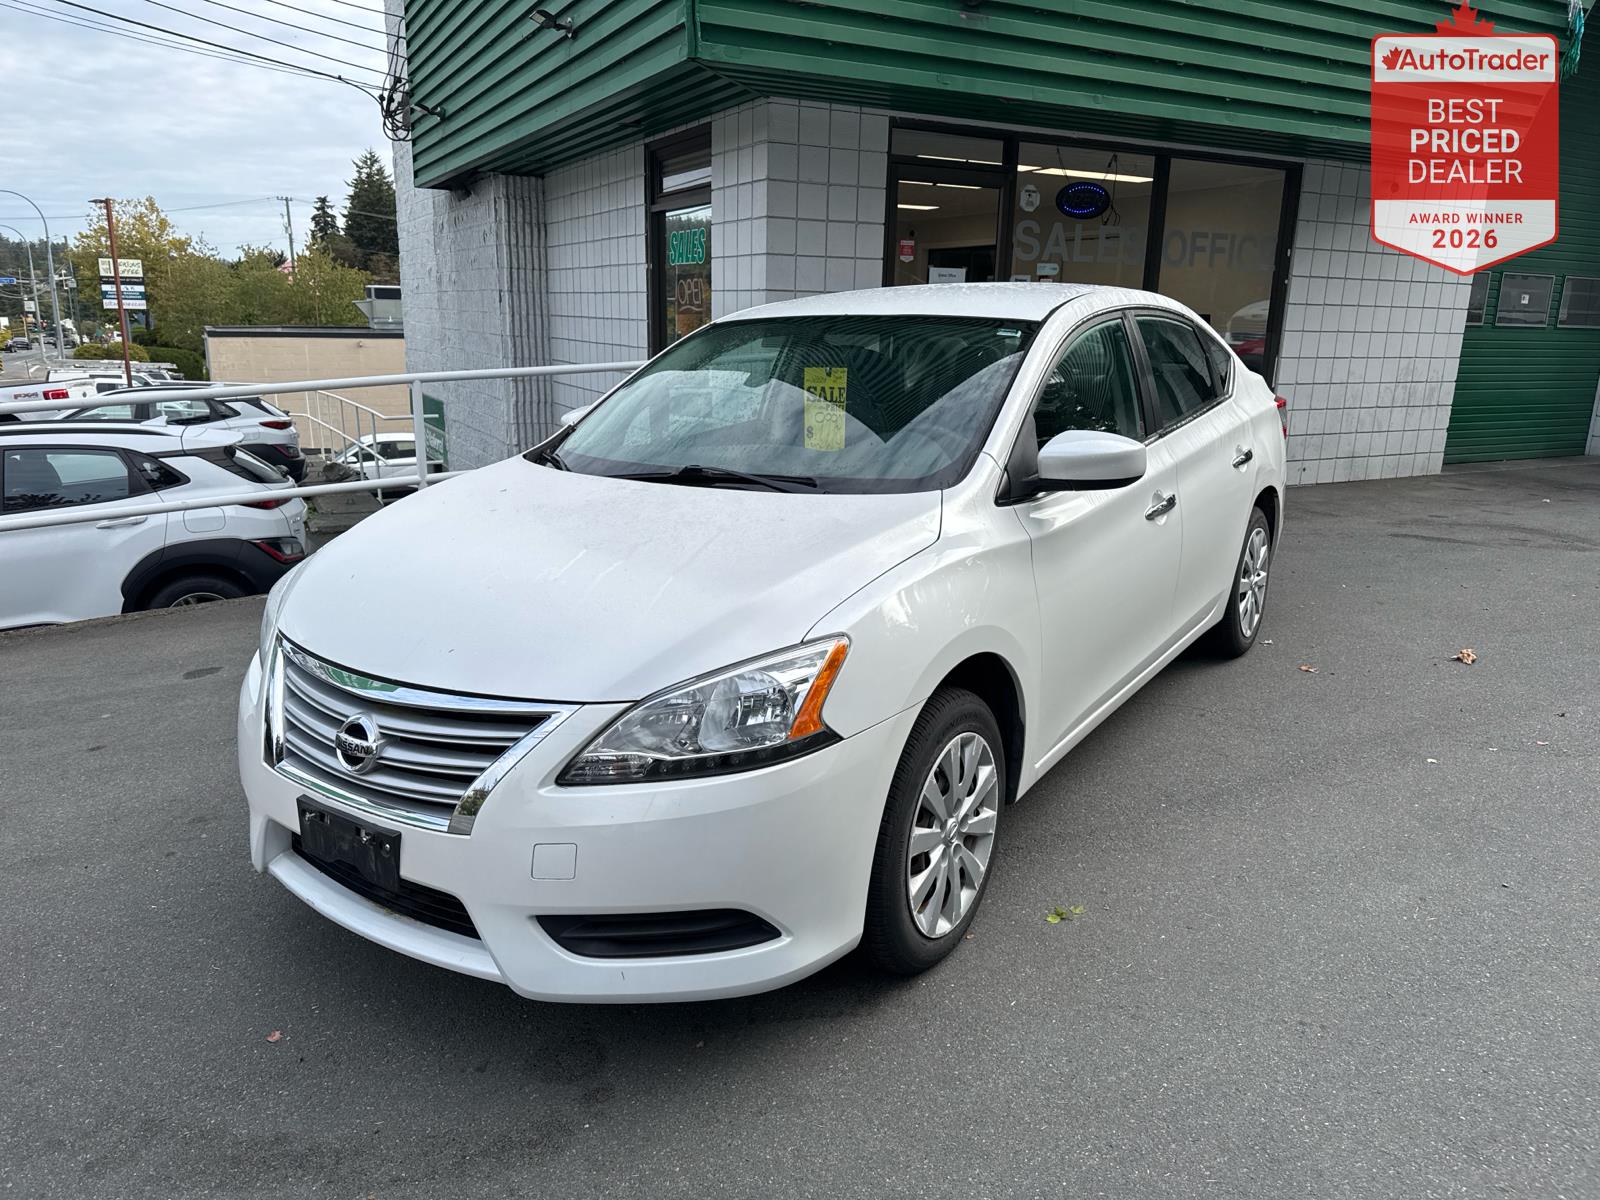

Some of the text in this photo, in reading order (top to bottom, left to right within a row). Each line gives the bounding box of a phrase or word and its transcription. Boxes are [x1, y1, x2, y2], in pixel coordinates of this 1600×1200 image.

[669, 227, 706, 265] SALES
[1014, 219, 1144, 266] SALES
[677, 278, 704, 305] OPEN
[805, 385, 846, 403] SALE
